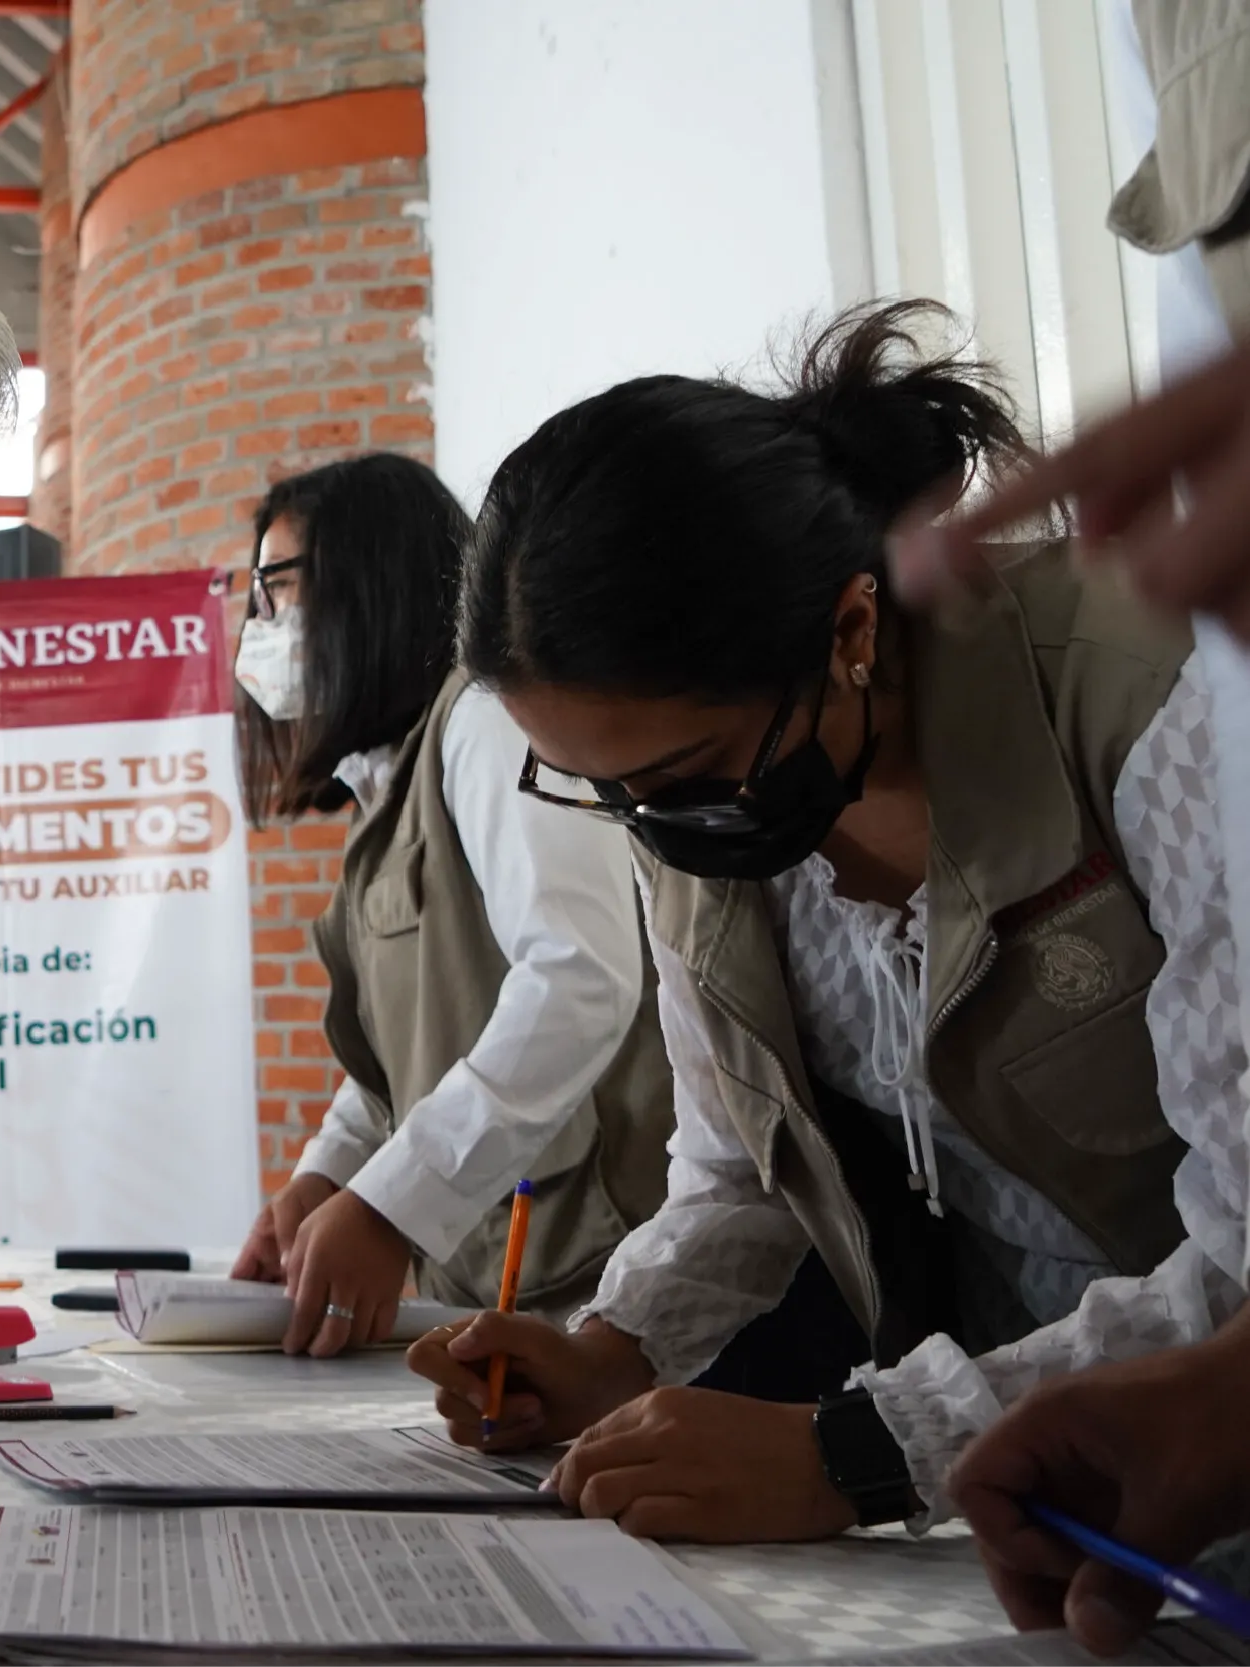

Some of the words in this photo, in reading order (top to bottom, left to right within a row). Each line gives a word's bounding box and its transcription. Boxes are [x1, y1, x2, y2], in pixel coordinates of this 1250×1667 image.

[119, 750, 209, 789] TUS
[0, 878, 41, 903] TU
[52, 867, 211, 899] AUXILIAR
[41, 945, 92, 972] de:
